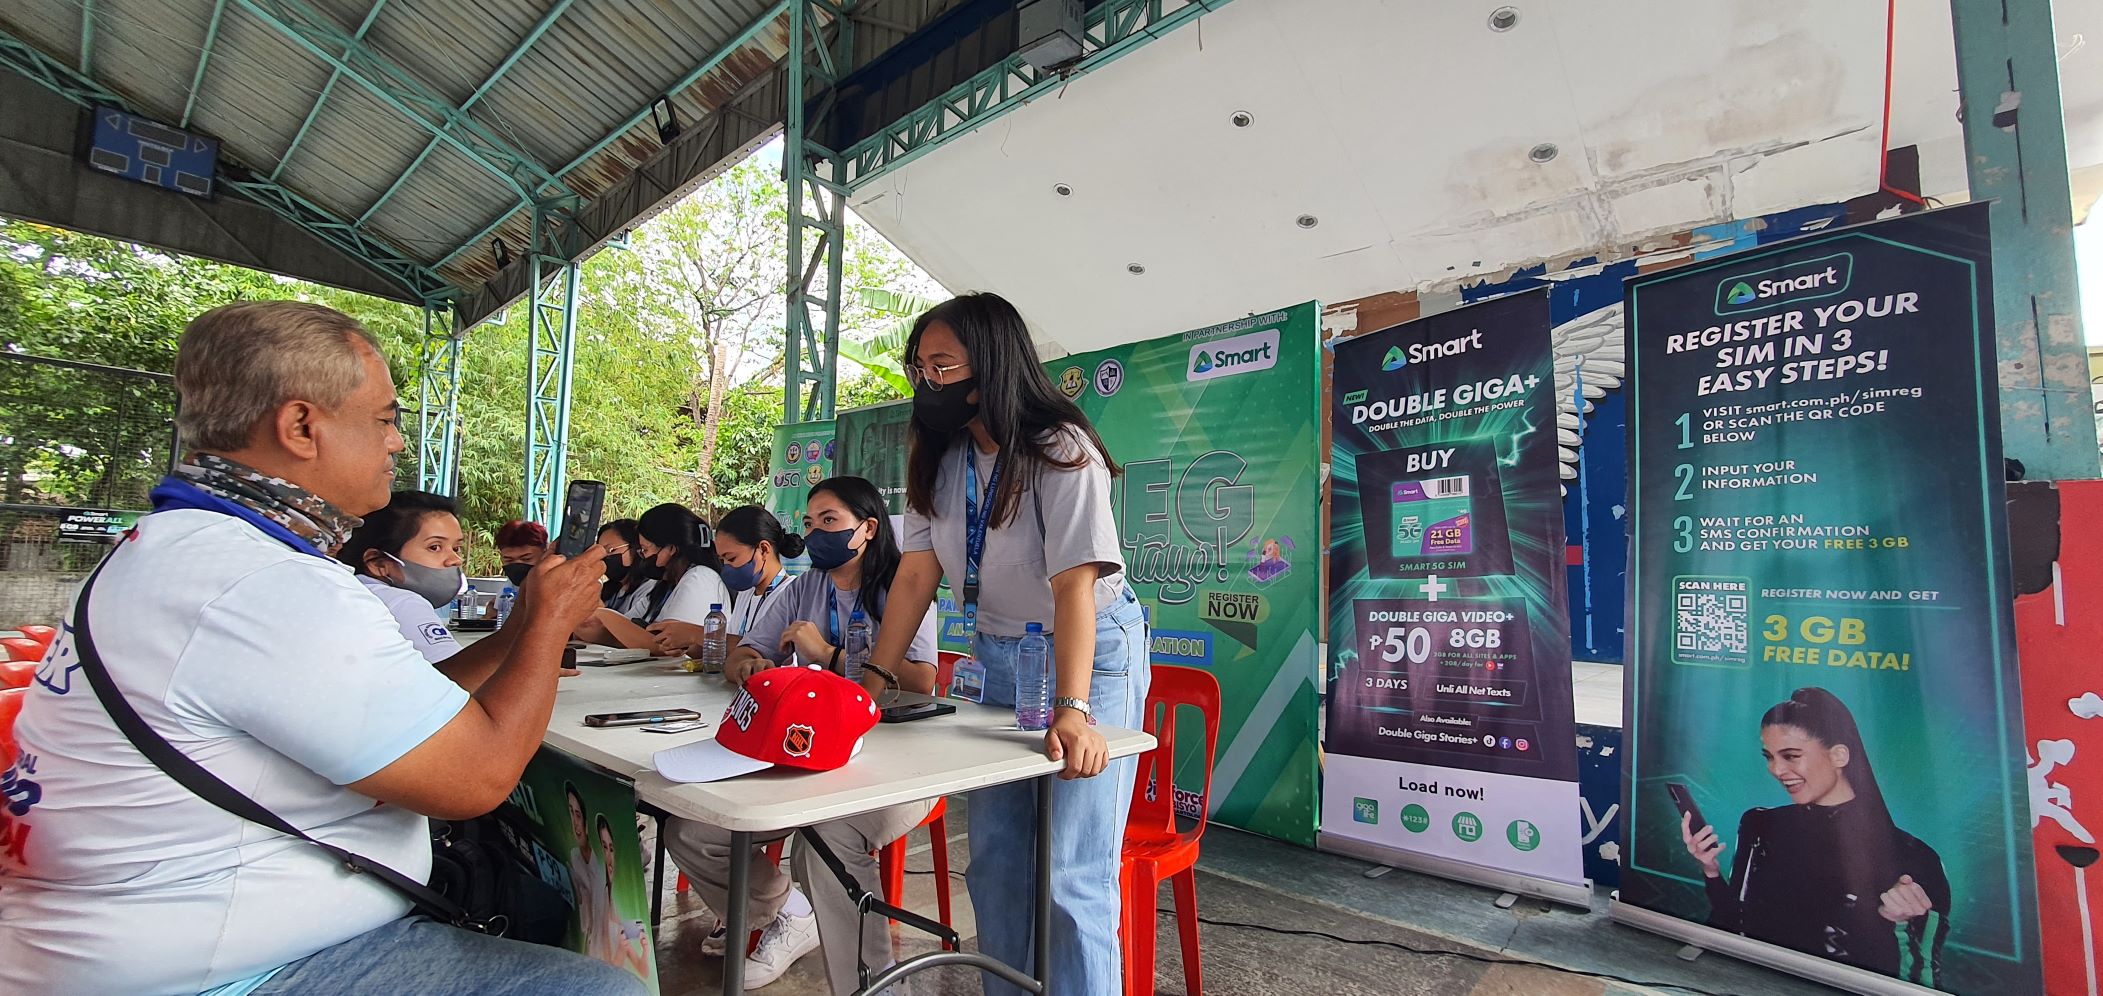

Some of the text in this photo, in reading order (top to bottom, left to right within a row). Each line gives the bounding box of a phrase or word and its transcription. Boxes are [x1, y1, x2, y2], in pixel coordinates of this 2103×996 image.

[1758, 266, 1837, 298] Smart
[1194, 318, 1257, 339] PARTNERSHIP
[1666, 292, 1919, 354] REGISTER YOUR
[1215, 342, 1271, 368] Smart
[1409, 329, 1482, 363] Smart
[1716, 329, 1852, 368] SIM IN 3
[1697, 349, 1889, 396] EASY STEPS!
[1352, 374, 1540, 424] DOUBLE GIGA+
[1703, 386, 1922, 418] VISIT smart.com.ph/simreg
[1369, 400, 1525, 433] DOUBLE THE DATA, DOUBLE THE POWER
[1703, 401, 1885, 431] OR SCAN THE QR CODE
[1674, 413, 1695, 449] 1
[1703, 431, 1756, 444] BELOW
[1406, 448, 1455, 473] BUY
[1702, 460, 1795, 476] INPUT YOUR
[1674, 463, 1695, 501] 2
[1702, 473, 1817, 489] INFORMATION
[1111, 450, 1254, 549] EG
[1700, 514, 1804, 527] WAIT FOR AN
[1430, 528, 1462, 539] 21 GB
[1673, 515, 1694, 554] 3
[1700, 525, 1870, 539] SMS CONFIRMATION
[1700, 537, 1909, 551] AND GET YOUR FREE 3 GB
[1399, 561, 1466, 571] SMART 5G SIM
[1679, 581, 1746, 591] SCAN HERE
[1761, 588, 1939, 601] REGISTER NOW AND GET
[1208, 592, 1259, 604] REGISTER
[1208, 601, 1260, 621] NOW
[1369, 611, 1515, 623] DOUBLE GIGA VIDEO+
[1449, 628, 1501, 648] 8GB
[1762, 614, 1867, 645] 3 GB
[1149, 636, 1205, 657] ATION
[1763, 645, 1911, 671] FREE DATA!
[1365, 678, 1408, 690] 3 DAYS
[1436, 684, 1512, 697] Unli All Net Texts
[1420, 714, 1472, 727] Also Available:
[1378, 727, 1479, 746] Double Giga Stories+
[1399, 776, 1485, 801] Load now!
